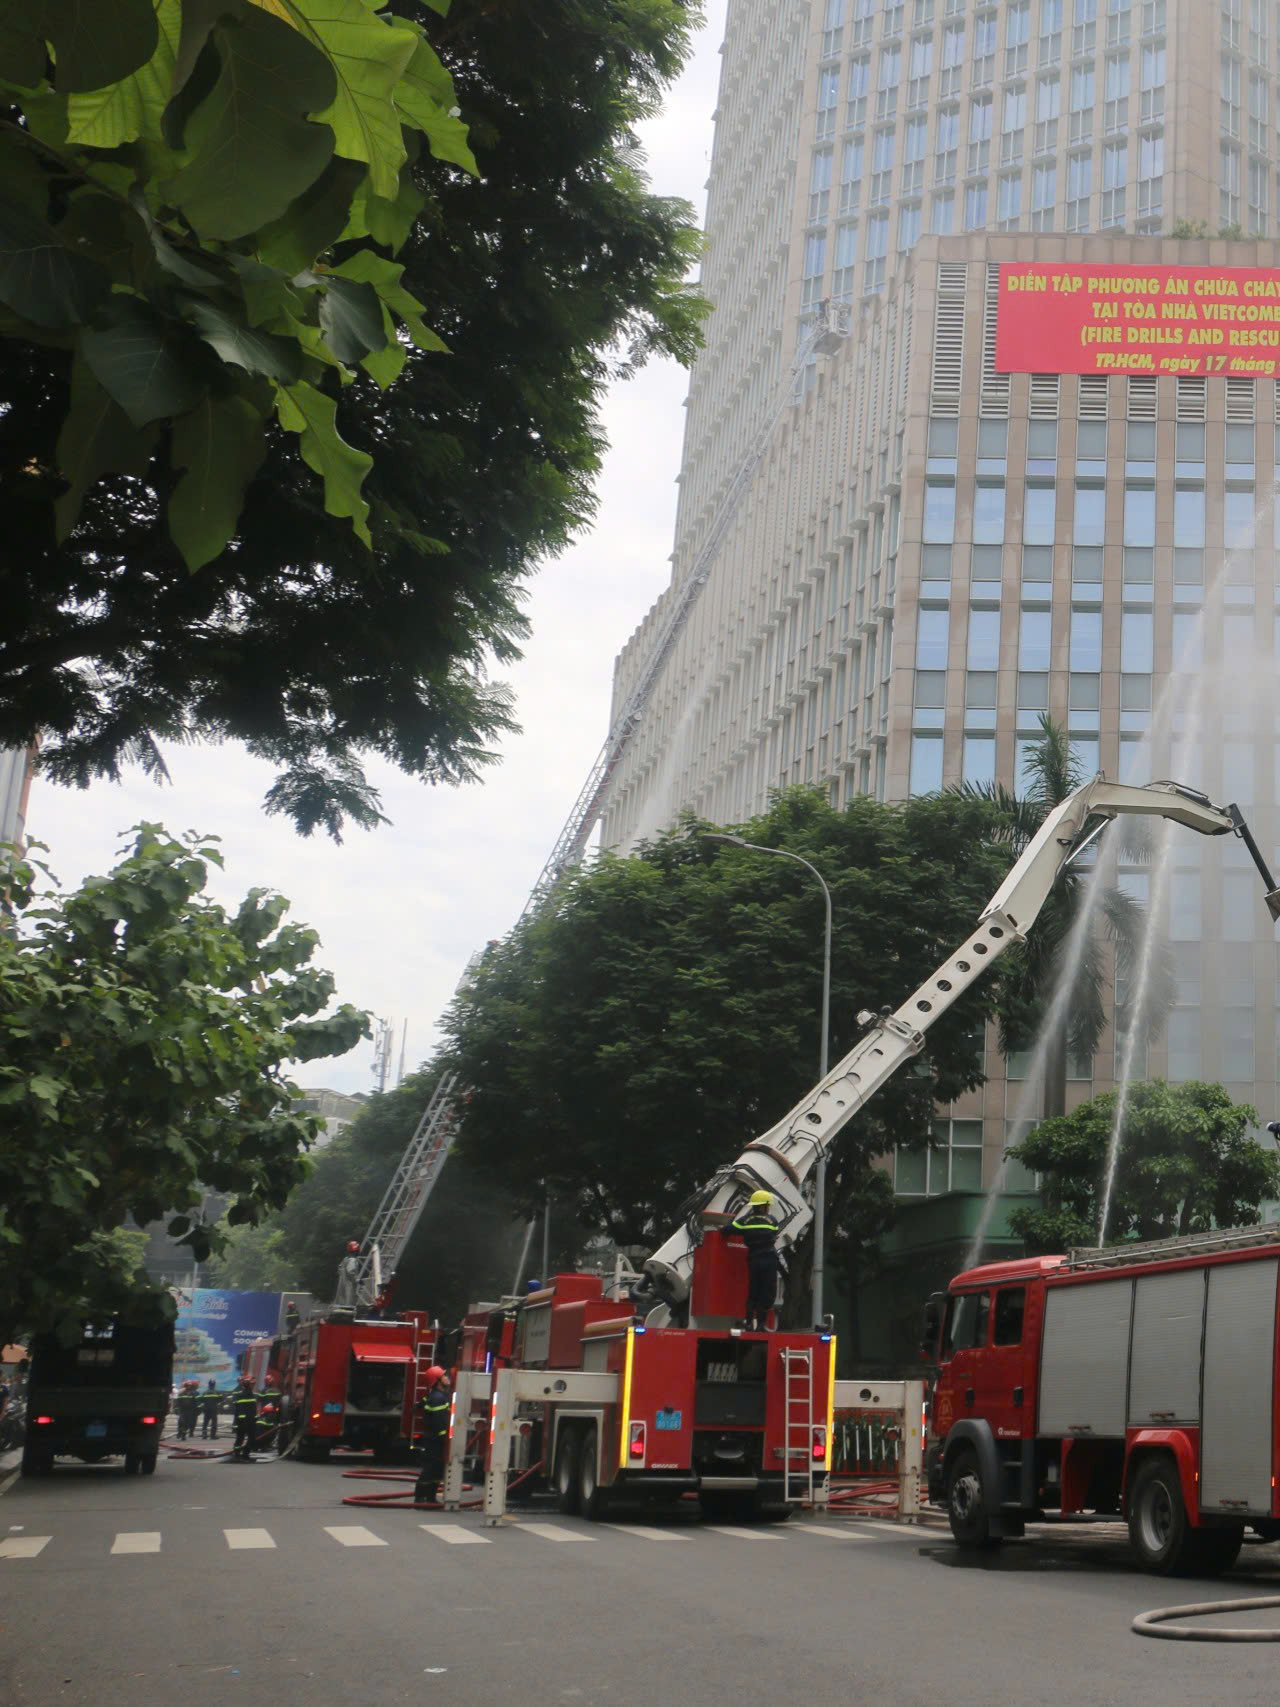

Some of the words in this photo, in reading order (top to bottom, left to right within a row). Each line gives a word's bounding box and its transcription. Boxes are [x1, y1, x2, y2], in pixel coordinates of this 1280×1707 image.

[1052, 273, 1083, 296] TẬP
[1087, 276, 1160, 294] PHƯƠNG
[1165, 275, 1189, 295] ÁN
[1092, 301, 1118, 323] TẠI
[1123, 299, 1156, 318] TÒA
[1162, 301, 1198, 320] NHÀ
[1081, 325, 1122, 346] (FIRE
[1127, 327, 1183, 344] DRILLS
[1188, 328, 1224, 345] AND
[1096, 353, 1155, 372] TP.HCM,
[1160, 354, 1200, 373] ngày
[1205, 355, 1227, 371] 17
[1230, 356, 1276, 374] tháng
[233, 1329, 269, 1338] COMING
